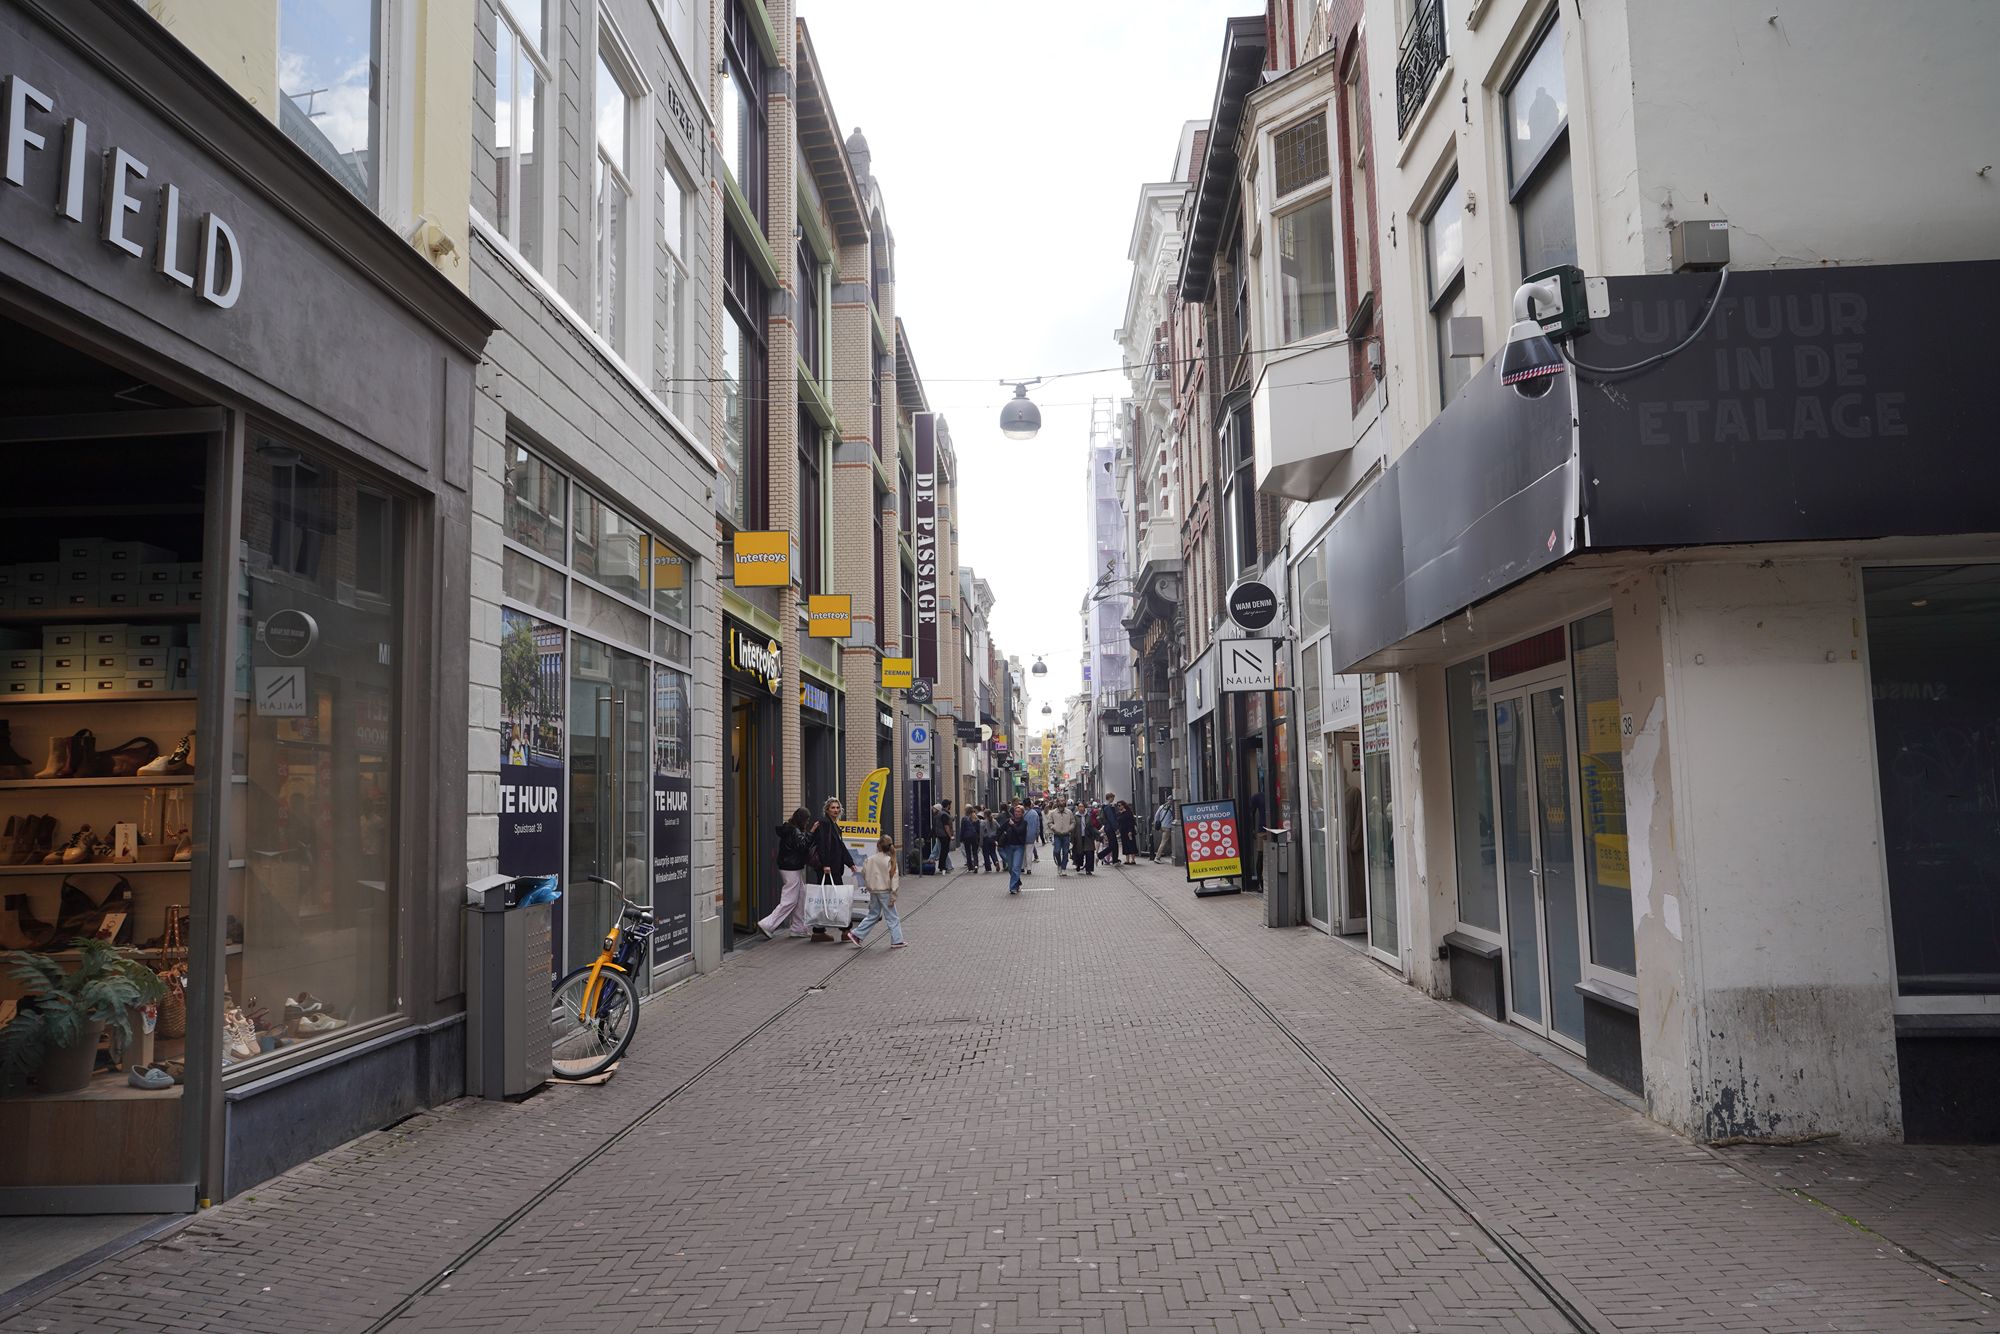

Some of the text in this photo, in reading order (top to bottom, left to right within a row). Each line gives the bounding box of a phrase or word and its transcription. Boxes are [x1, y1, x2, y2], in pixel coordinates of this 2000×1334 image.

[668, 82, 695, 146] 1848
[1, 74, 243, 310] FIELD
[1714, 342, 1867, 391] IN DE
[1638, 392, 1909, 446] ETALAGE
[916, 472, 936, 624] DE PASSAGE
[735, 552, 787, 563] Intertoys
[1235, 599, 1273, 611] WAM DENIM
[810, 610, 849, 620] Intertoys
[739, 632, 776, 681] Intertoys
[1226, 676, 1271, 685] NAILAH
[1331, 695, 1351, 715] NAILAH
[1623, 717, 1632, 735] 38
[499, 784, 558, 814] TE HUUR
[655, 790, 666, 812] TE
[666, 790, 688, 812] HUUR
[1186, 811, 1231, 822] LEEG VERKOOP
[1196, 805, 1219, 813] OUTLET
[514, 823, 543, 836] Spuistraat 39
[840, 825, 878, 835] ZEEMAN
[1192, 866, 1208, 874] ALLES
[1209, 865, 1223, 873] MOET
[808, 897, 844, 905] PRIMARK
